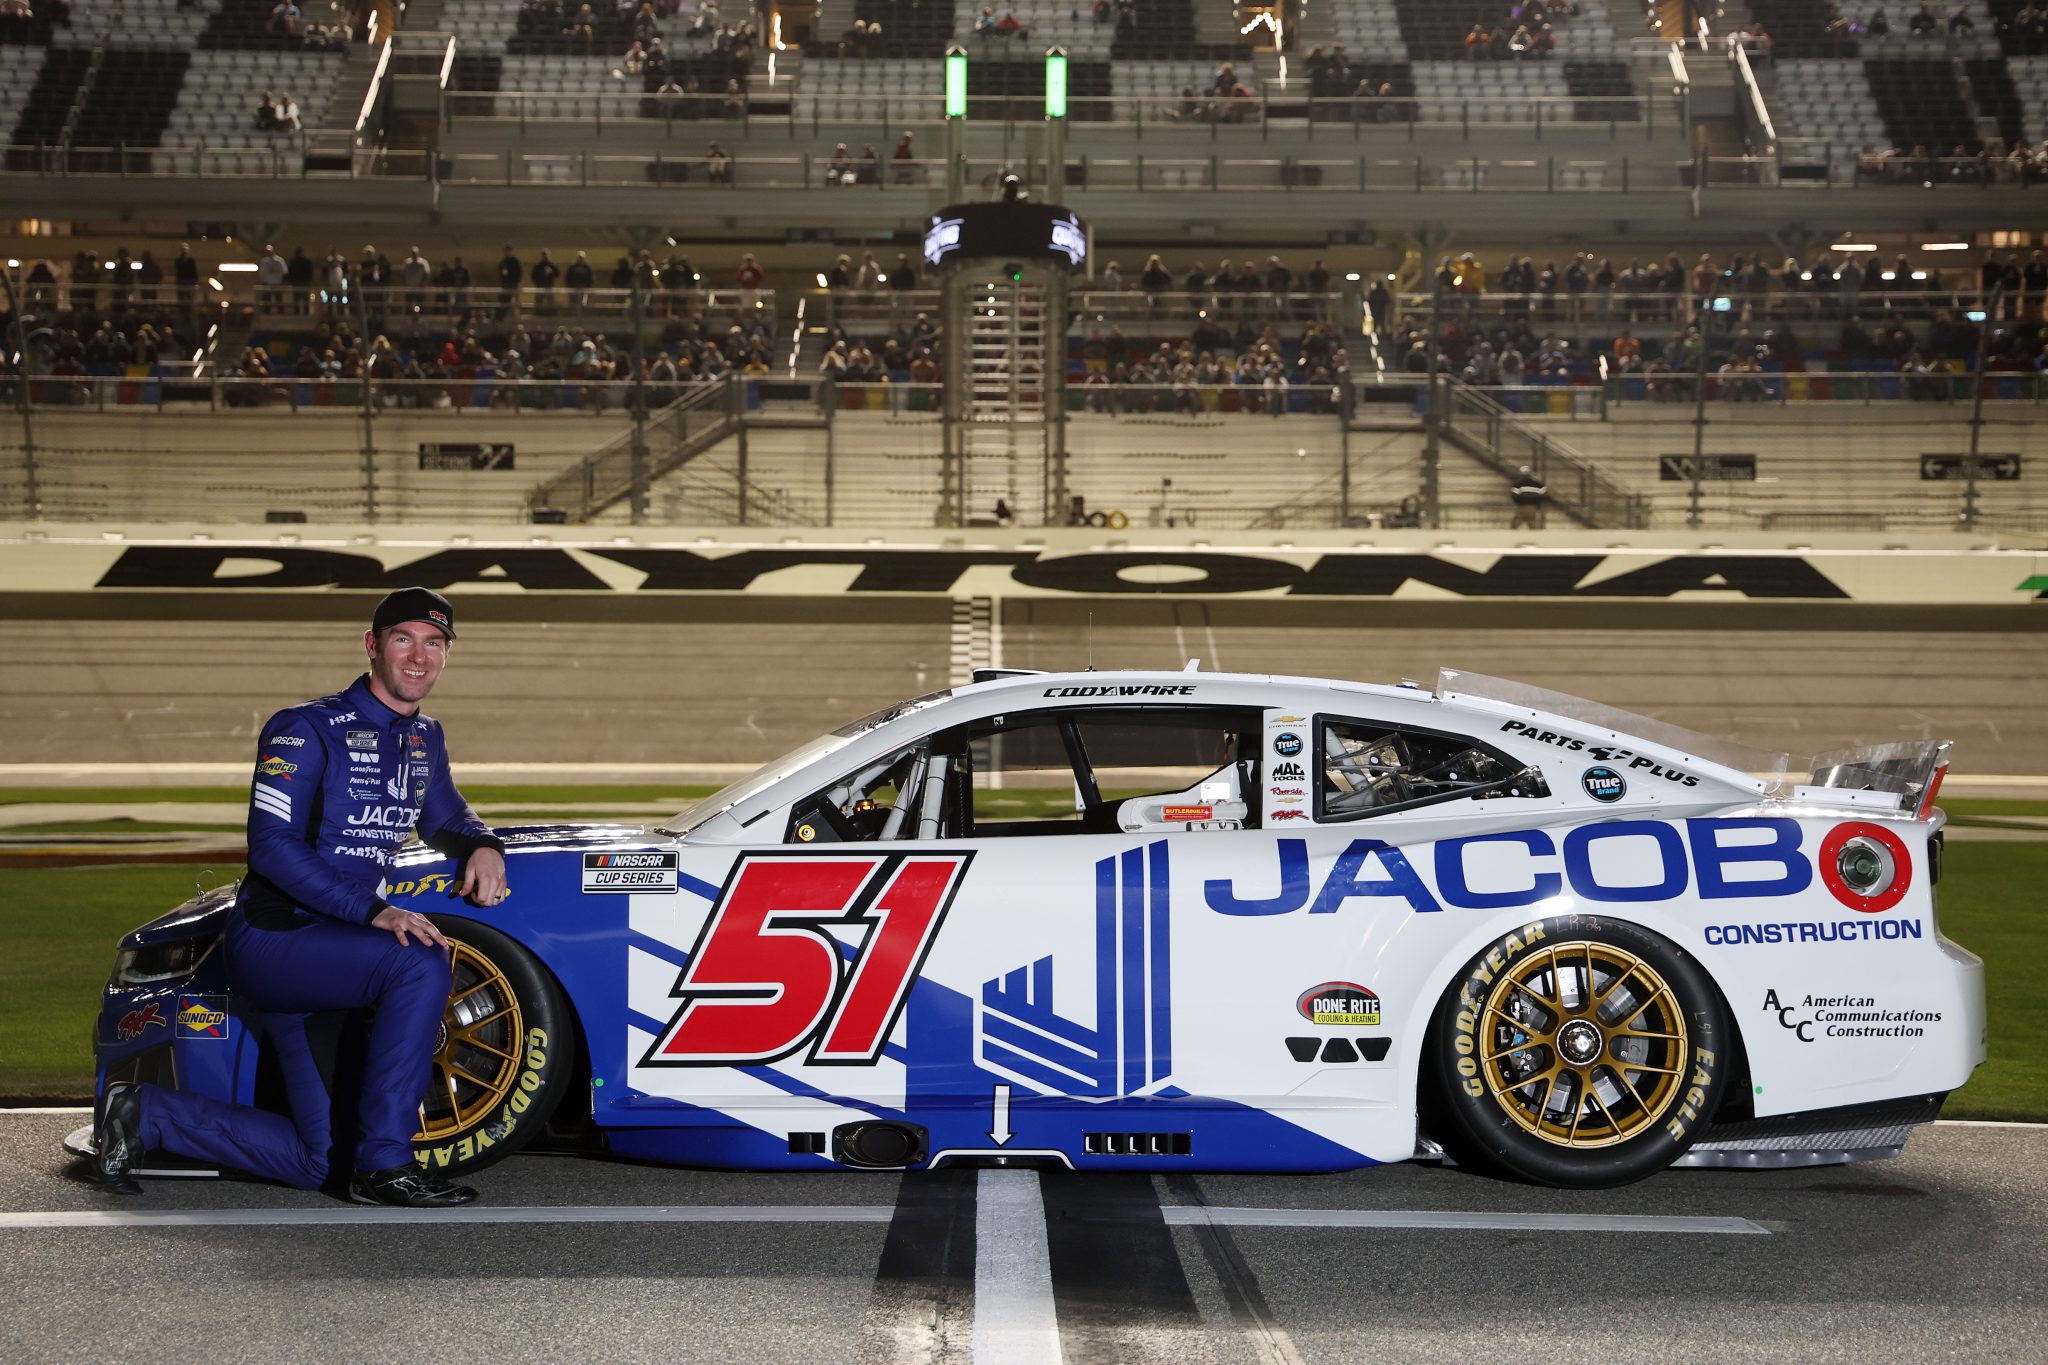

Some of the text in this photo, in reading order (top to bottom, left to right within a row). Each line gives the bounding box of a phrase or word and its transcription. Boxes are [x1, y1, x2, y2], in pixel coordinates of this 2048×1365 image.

[95, 545, 1852, 599] DAYTONA
[1043, 684, 1197, 698] CODY WARE
[270, 735, 306, 748] NASCAR
[1499, 719, 1701, 788] PARTS PLUS
[259, 762, 298, 774] SUNOCO
[1272, 762, 1306, 776] MAC
[1586, 777, 1621, 790] True
[1597, 787, 1620, 795] Brand
[612, 855, 664, 867] NASCAR
[1203, 817, 1813, 917] JACOB
[595, 872, 665, 884] CUP SERIES
[1703, 918, 1923, 946] CONSTRUCTION
[635, 850, 978, 1068] 51
[1313, 998, 1380, 1014] DONE RITE
[1801, 994, 1875, 1007] American
[1454, 919, 1548, 1098] GOODYEAR
[179, 1012, 224, 1025] SUNOCO
[1317, 1014, 1376, 1023] COOLING & HEATING
[1814, 1009, 1943, 1022] Communications
[1826, 1024, 1924, 1037] Construction
[1665, 1045, 1715, 1142] EAGLE
